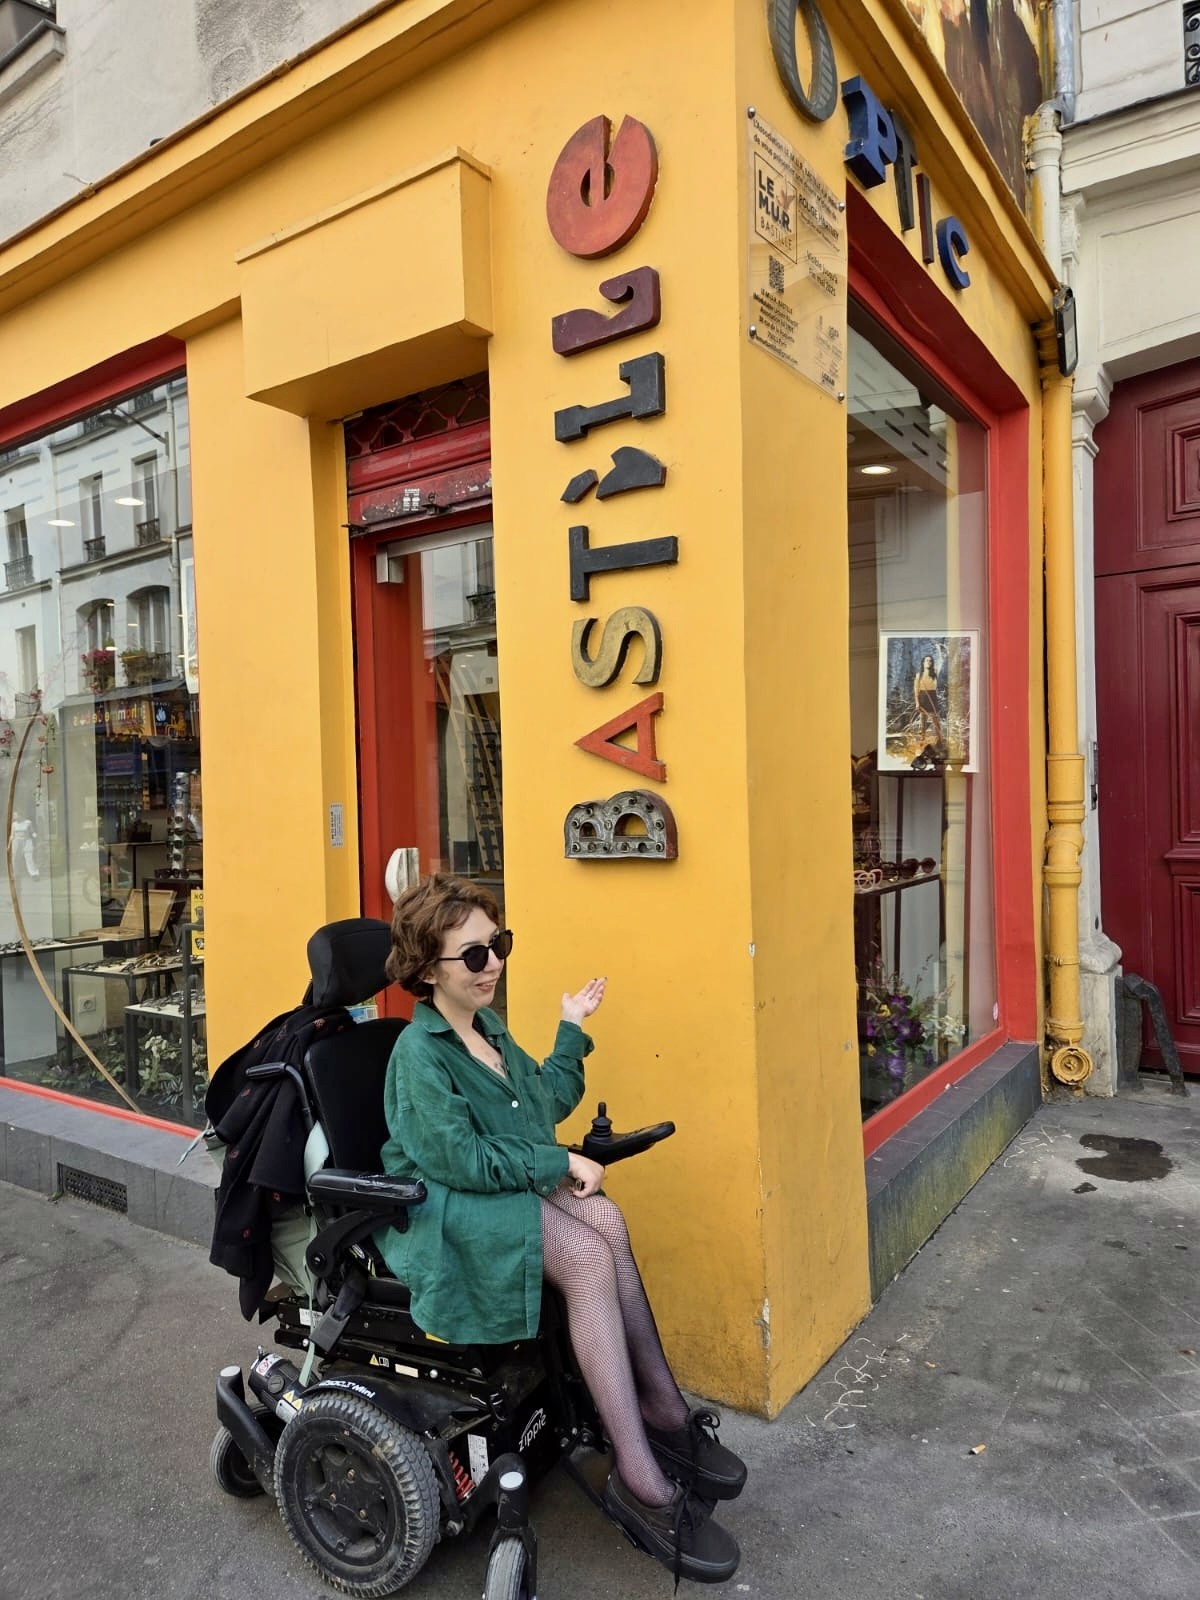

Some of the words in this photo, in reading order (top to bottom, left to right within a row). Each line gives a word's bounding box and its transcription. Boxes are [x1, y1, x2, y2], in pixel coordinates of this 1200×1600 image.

[767, 0, 971, 290] OPTIC
[759, 169, 774, 199] LE
[759, 189, 792, 234] M.U.R.
[799, 193, 818, 220] ROUGE
[760, 216, 792, 251] BASTILLE
